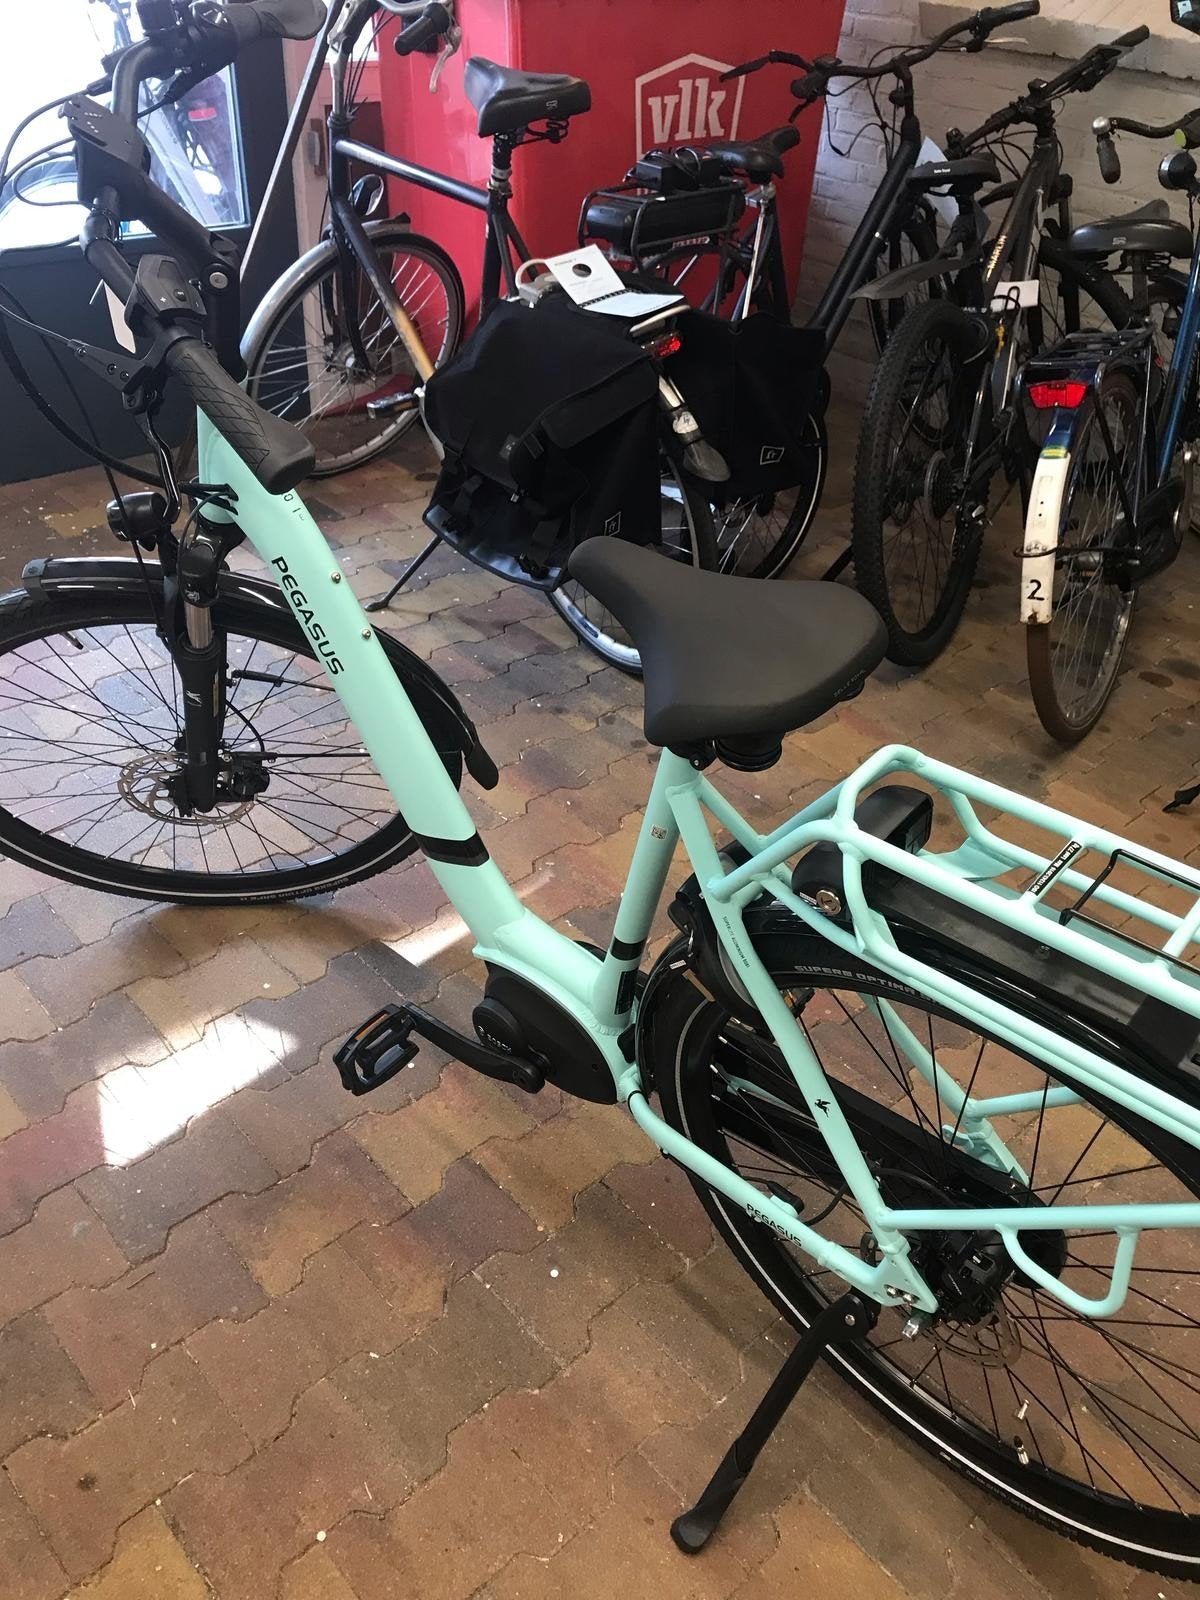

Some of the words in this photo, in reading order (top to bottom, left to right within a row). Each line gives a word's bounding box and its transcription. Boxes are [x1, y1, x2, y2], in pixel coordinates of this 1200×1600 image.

[648, 77, 726, 144] vlk
[987, 235, 1007, 269] MARLIN
[1027, 579, 1045, 601] 2
[271, 556, 345, 675] PEGASUS
[793, 964, 854, 978] SUPERB
[855, 972, 917, 995] OPTIMA
[746, 1203, 802, 1247] PEGASUS
